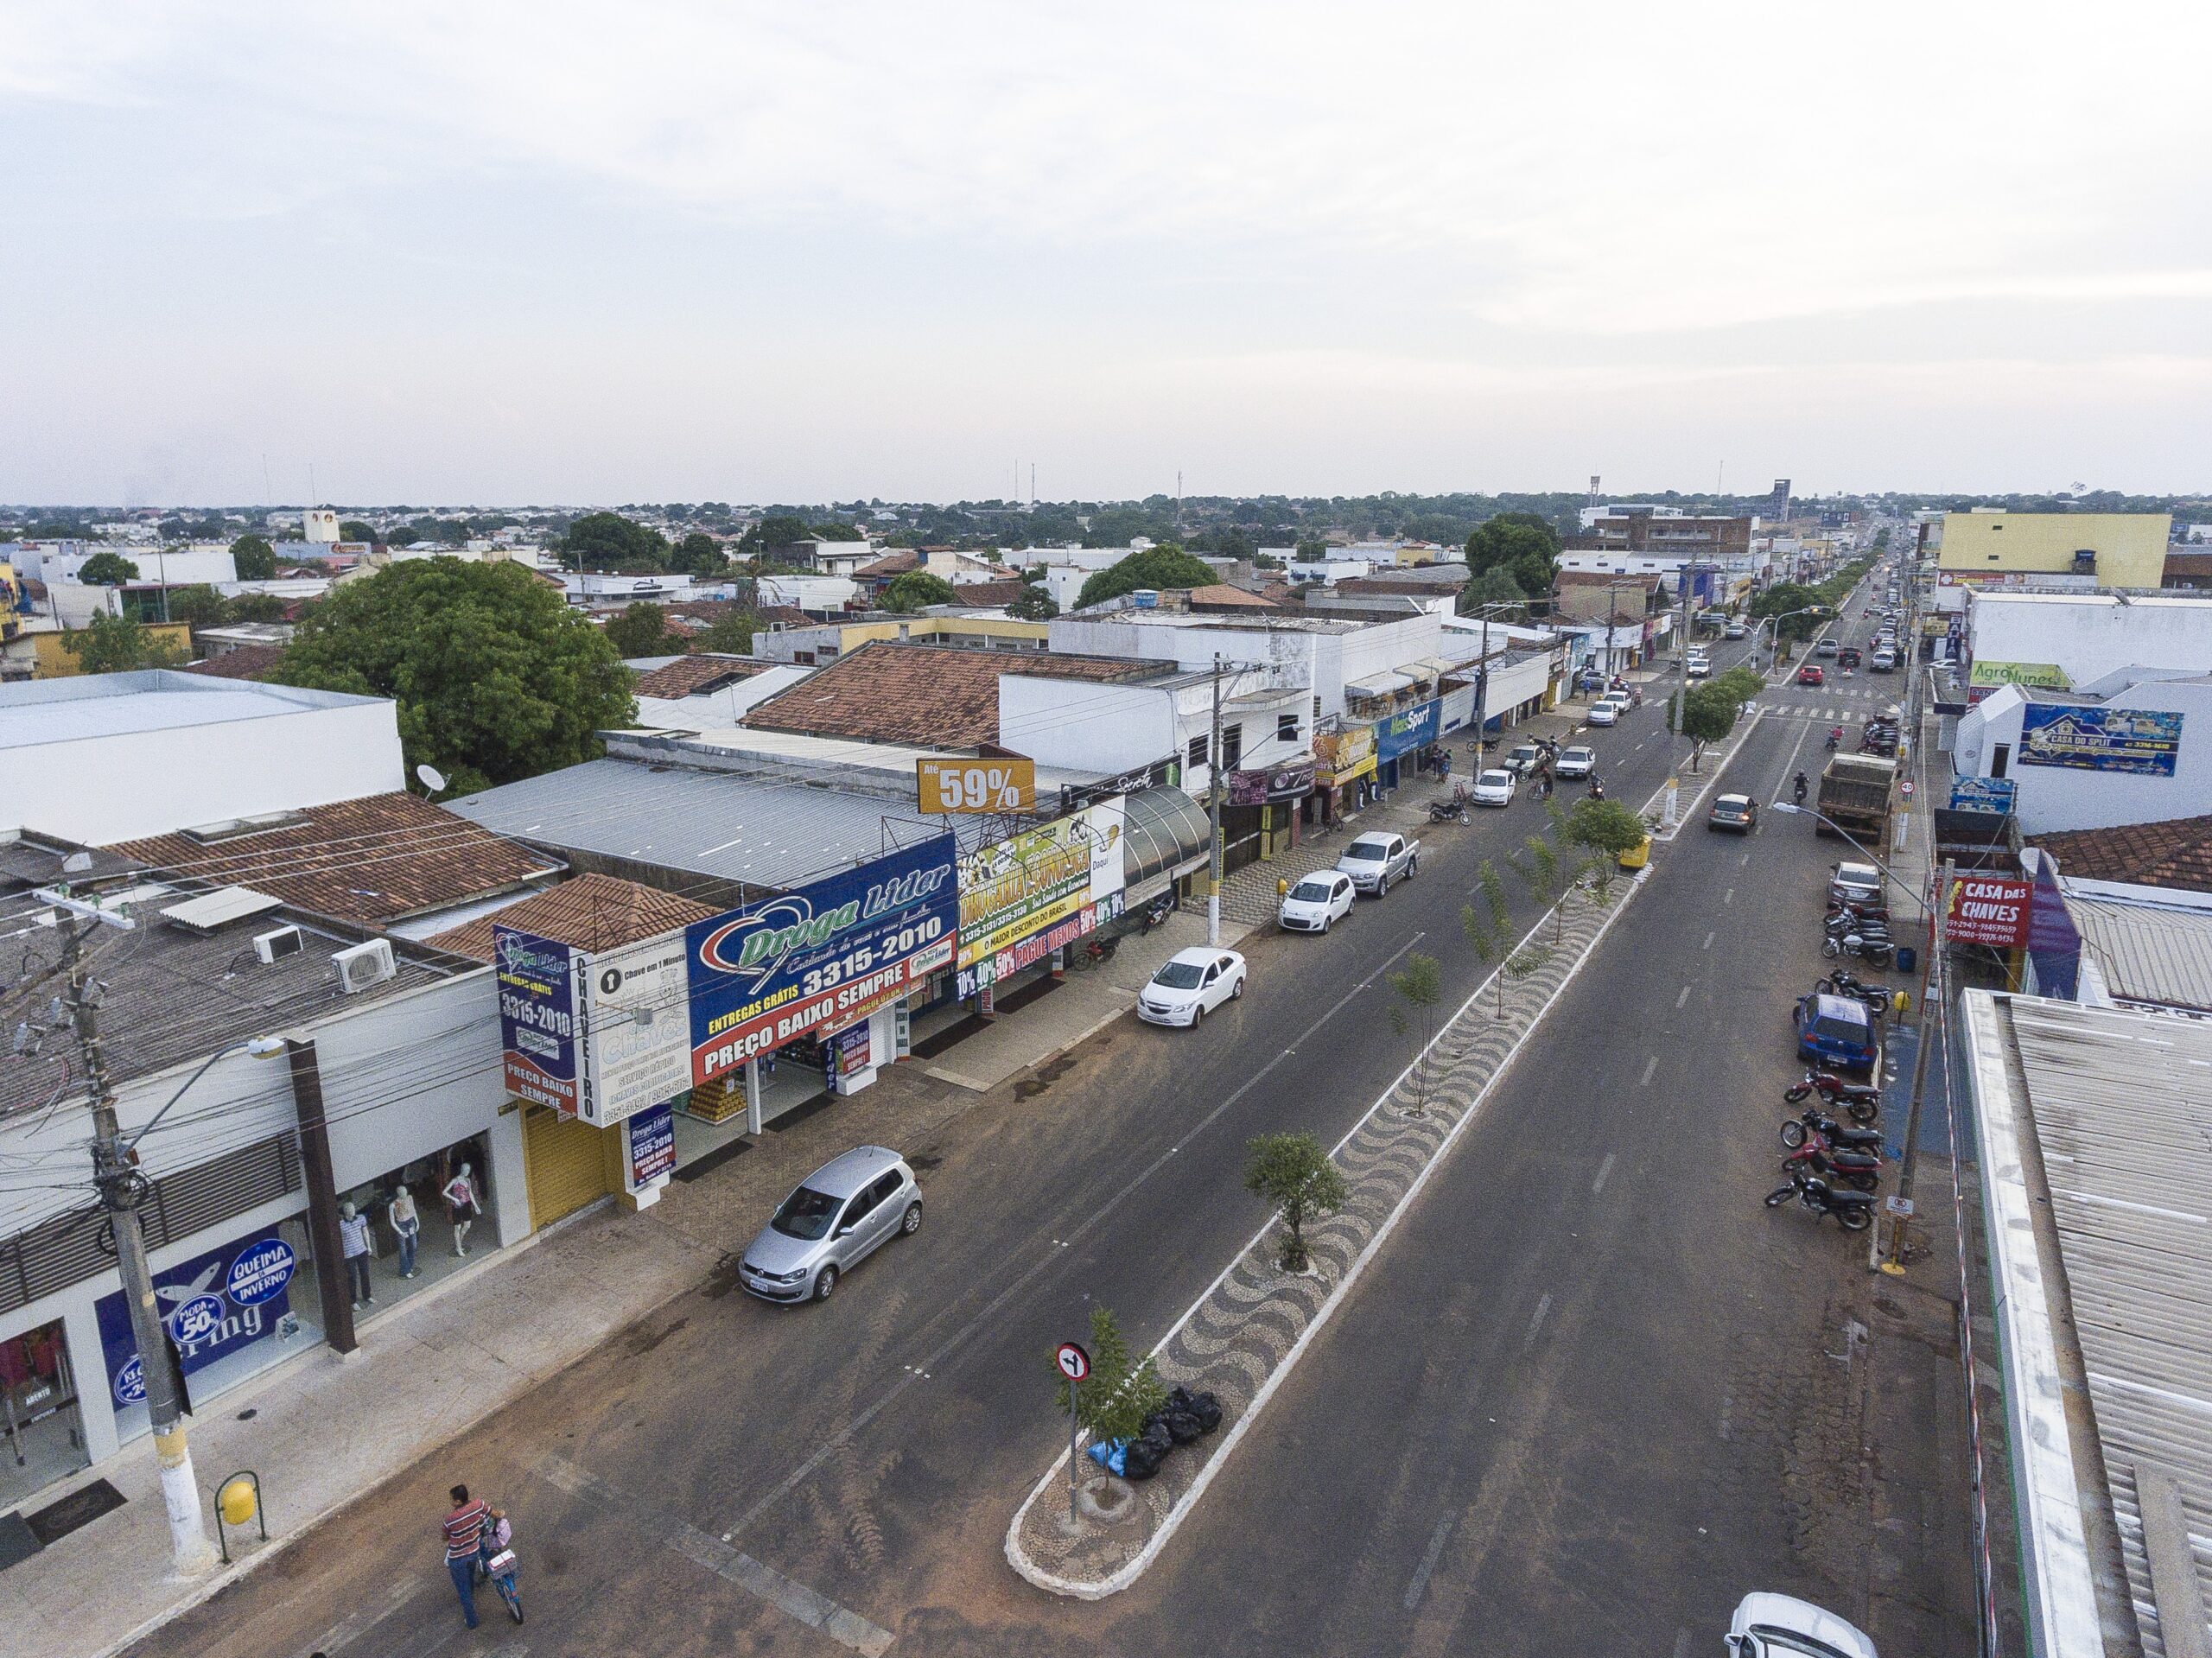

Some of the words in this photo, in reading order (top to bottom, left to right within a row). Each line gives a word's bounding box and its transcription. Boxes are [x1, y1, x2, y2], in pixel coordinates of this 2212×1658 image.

[1947, 616, 1961, 653] BAHIA
[2051, 735, 2072, 744] CASA
[2088, 738, 2111, 746] SPLIT
[924, 764, 939, 775] Até
[939, 767, 1020, 811] 59%
[1092, 854, 1109, 871] Daqui
[1965, 882, 2004, 900] CASA
[2004, 888, 2026, 899] DAS
[739, 899, 861, 969] Droga
[863, 863, 951, 919] Lider
[1080, 908, 1096, 930] 50%
[1961, 901, 2020, 923] CHAVES
[983, 940, 989, 950] O
[990, 927, 1010, 948] MAIOR
[1010, 917, 1039, 940] DESCONTO
[1040, 913, 1048, 925] DO
[1048, 903, 1067, 922] BRASIL
[1015, 933, 1046, 969] PAGUE
[1047, 918, 1080, 954] MENOS
[624, 964, 645, 981] Chave
[646, 963, 658, 973] em
[664, 952, 686, 967] Minuto
[709, 999, 762, 1036] ENTREGAS
[763, 983, 799, 1009] GRÁTIS
[804, 916, 942, 995] 3315-2010
[976, 962, 997, 987] 40%
[995, 953, 1015, 978] 50%
[499, 971, 529, 988] ENTREGAS
[957, 969, 976, 997] 10%
[502, 993, 571, 1037] 3315-2010
[857, 997, 880, 1014] PAGUE
[704, 1026, 773, 1075] PREÇO
[778, 998, 834, 1040] BAIXO
[837, 963, 904, 1010] SEMPRE
[576, 956, 594, 1118] CHAVEIRO
[601, 1020, 688, 1065] Chaves
[506, 1063, 540, 1085] PREÇO
[541, 1075, 574, 1098] BAIXO
[520, 1083, 562, 1109] SEMPRE
[653, 1115, 671, 1129] Lider
[633, 1133, 672, 1159] 3315-2010
[635, 1153, 655, 1170] PREÇO
[655, 1145, 673, 1159] BAIXO
[641, 1159, 664, 1175] SEMPRE
[234, 1245, 287, 1280] QUEIMA
[239, 1269, 287, 1301] INVERNO
[179, 1300, 207, 1323] MODA
